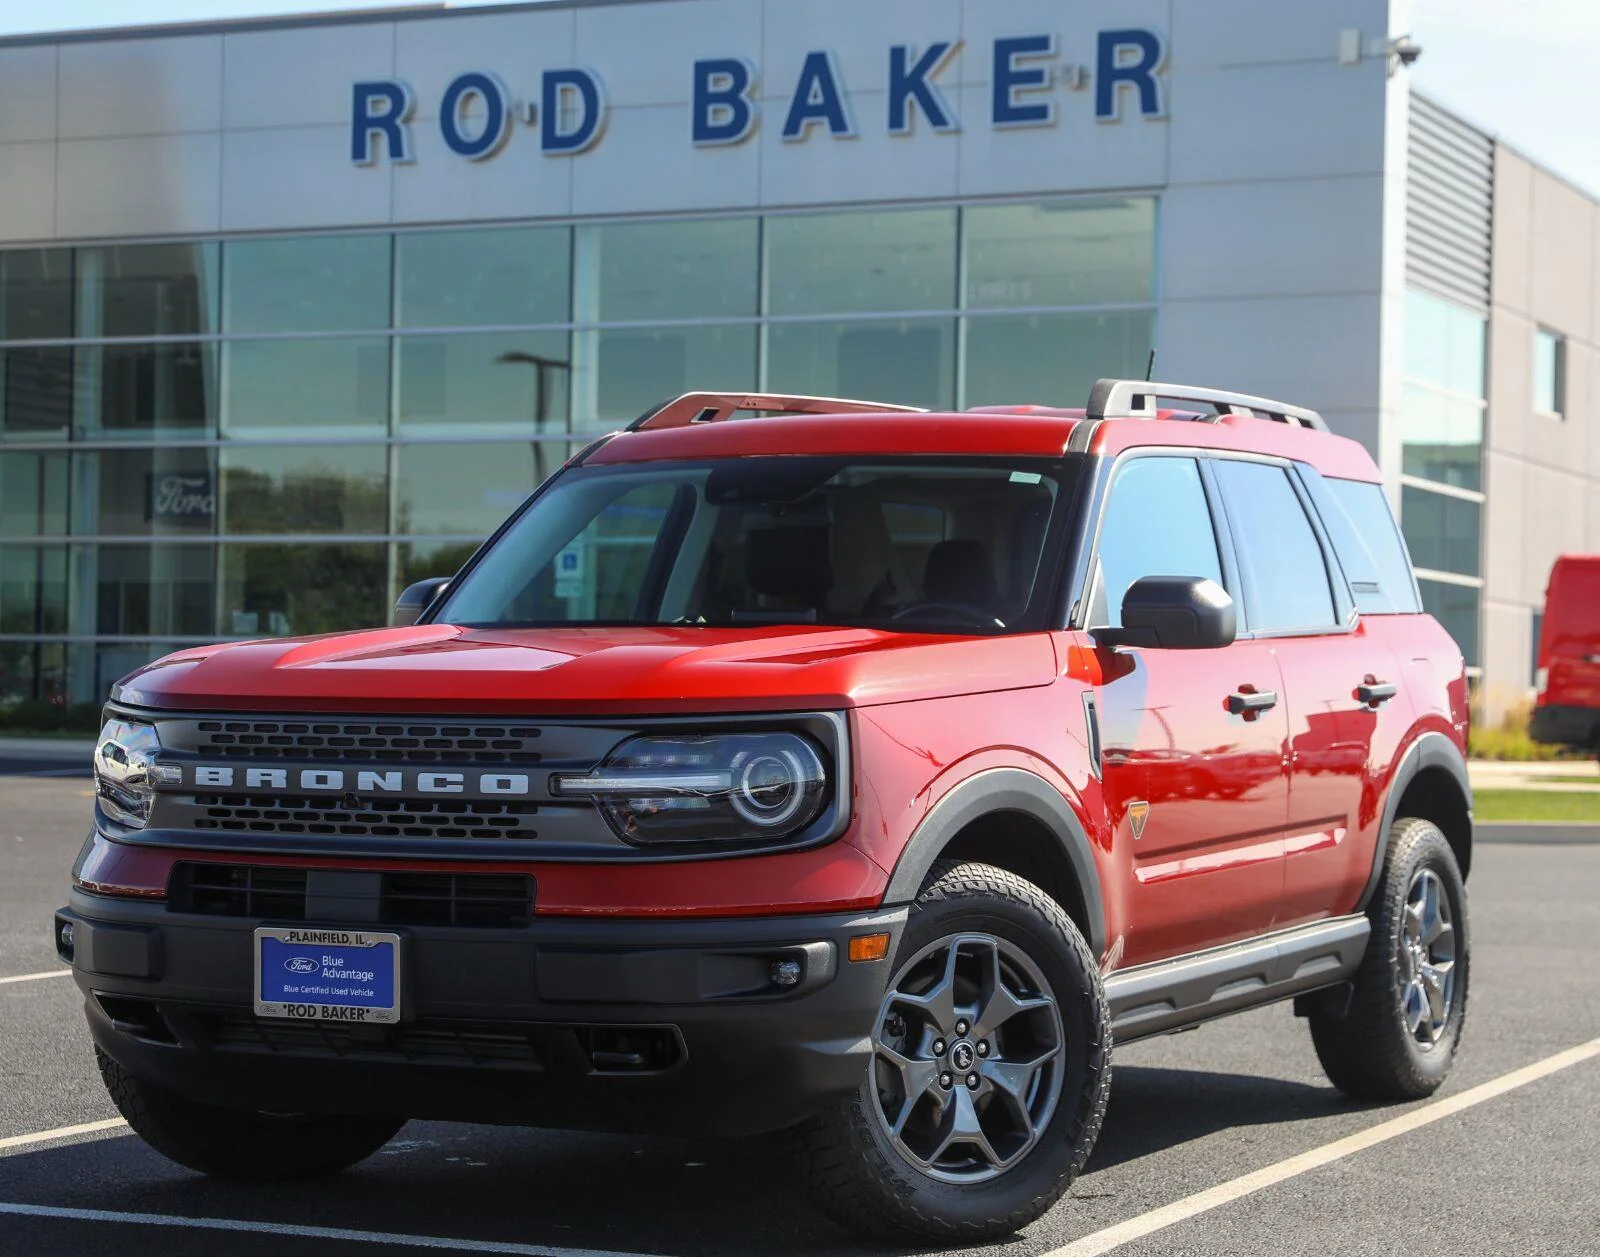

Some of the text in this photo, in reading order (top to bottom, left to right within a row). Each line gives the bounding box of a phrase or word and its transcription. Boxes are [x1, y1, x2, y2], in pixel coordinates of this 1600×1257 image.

[352, 28, 1168, 165] ROD BAKER
[195, 766, 529, 794] BRONCO
[290, 932, 366, 945] PLAINFIELD, IL
[290, 958, 313, 971] Ford
[322, 955, 344, 966] Blue
[322, 968, 374, 982] Advantage
[284, 985, 374, 997] Blue Certified Used Vehicle
